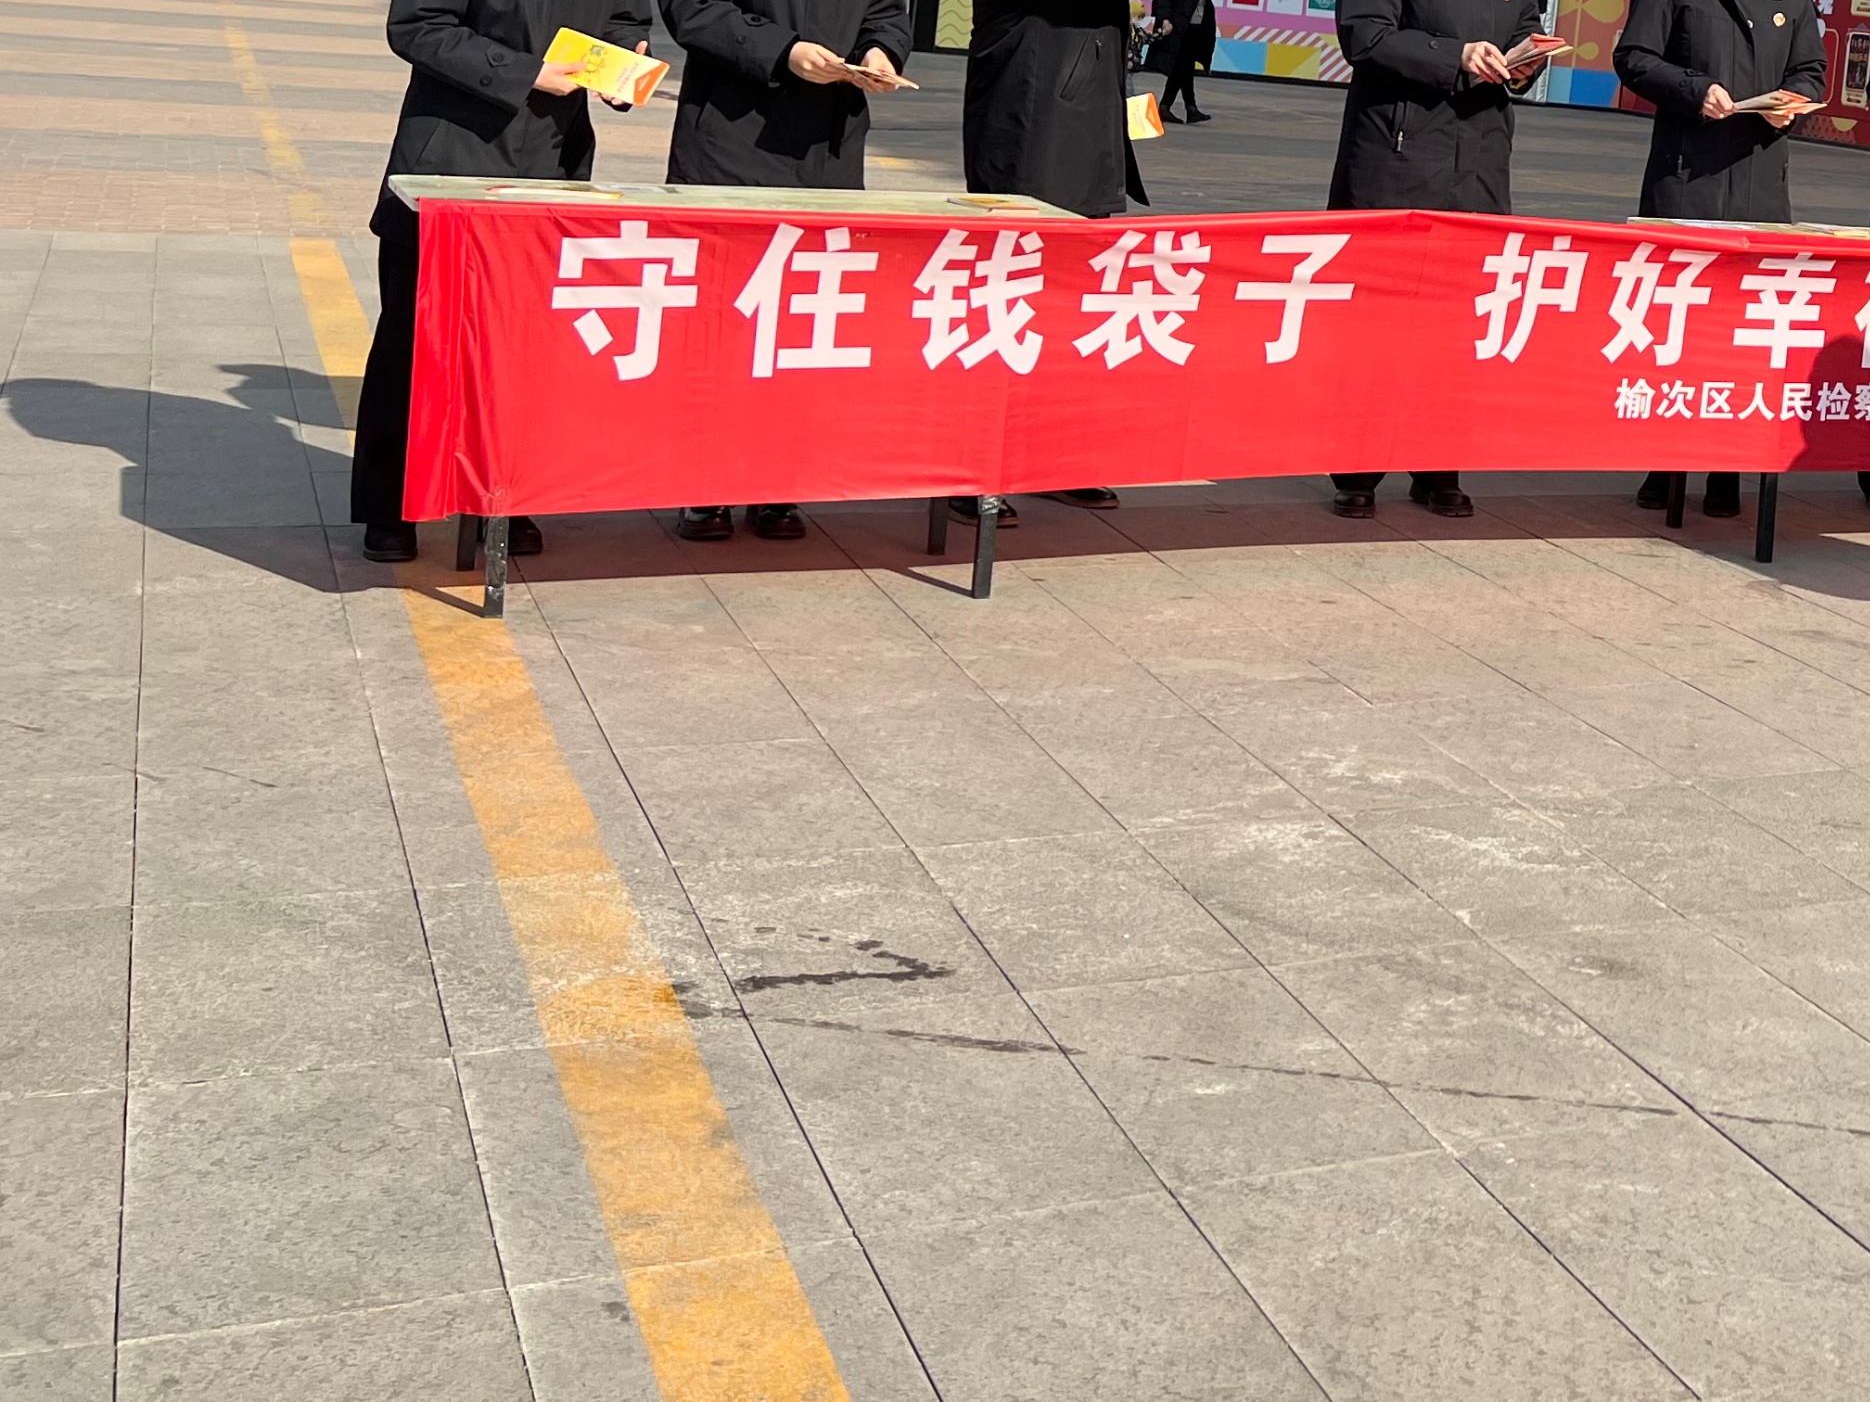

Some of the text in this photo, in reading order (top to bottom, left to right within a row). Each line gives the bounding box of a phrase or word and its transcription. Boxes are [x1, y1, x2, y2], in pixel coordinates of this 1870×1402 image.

[551, 219, 1356, 381] 守住钱袋子
